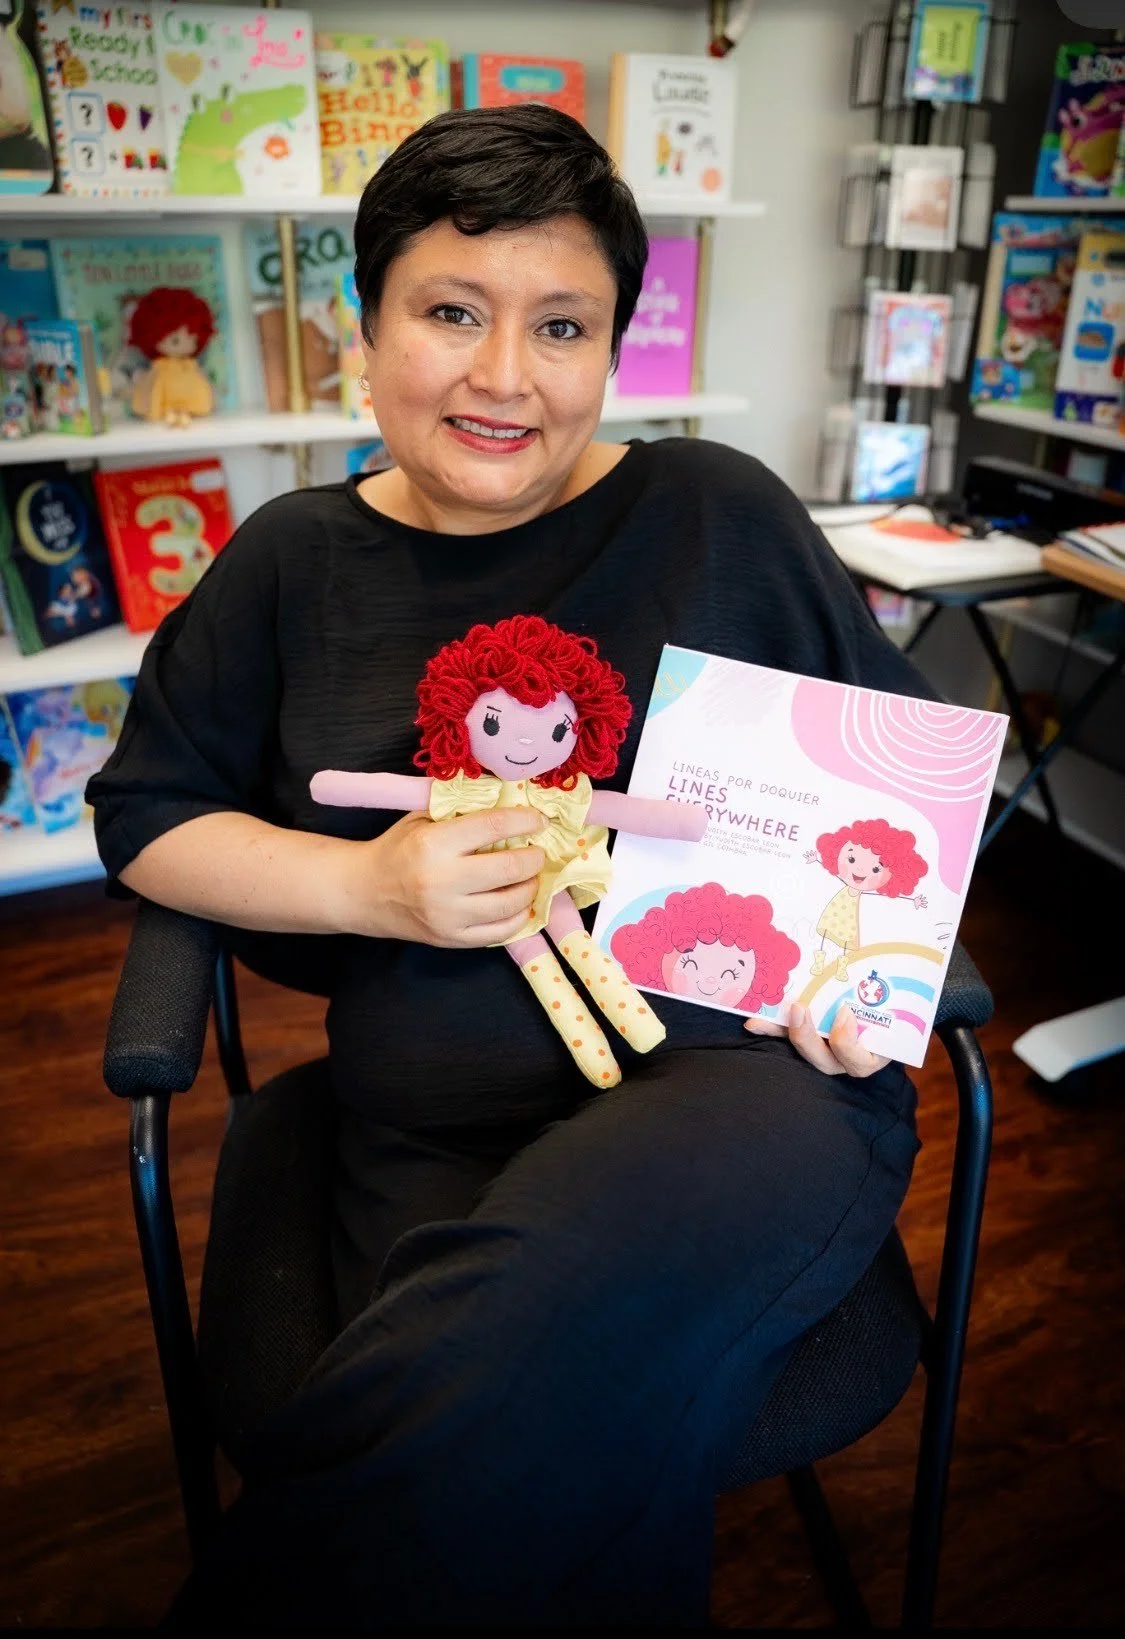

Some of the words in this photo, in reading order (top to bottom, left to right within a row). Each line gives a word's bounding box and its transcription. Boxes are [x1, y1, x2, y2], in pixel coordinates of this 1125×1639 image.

[68, 25, 140, 59] Ready
[89, 59, 159, 85] Schoo
[320, 89, 420, 117] Hello
[135, 495, 219, 597] 3
[668, 775, 728, 803] LINES
[672, 760, 720, 782] LINEAS
[727, 775, 753, 790] POR
[759, 783, 821, 806] DOQUIER
[666, 794, 800, 842] RYWHERE
[850, 1007, 892, 1026] NCINNATI
